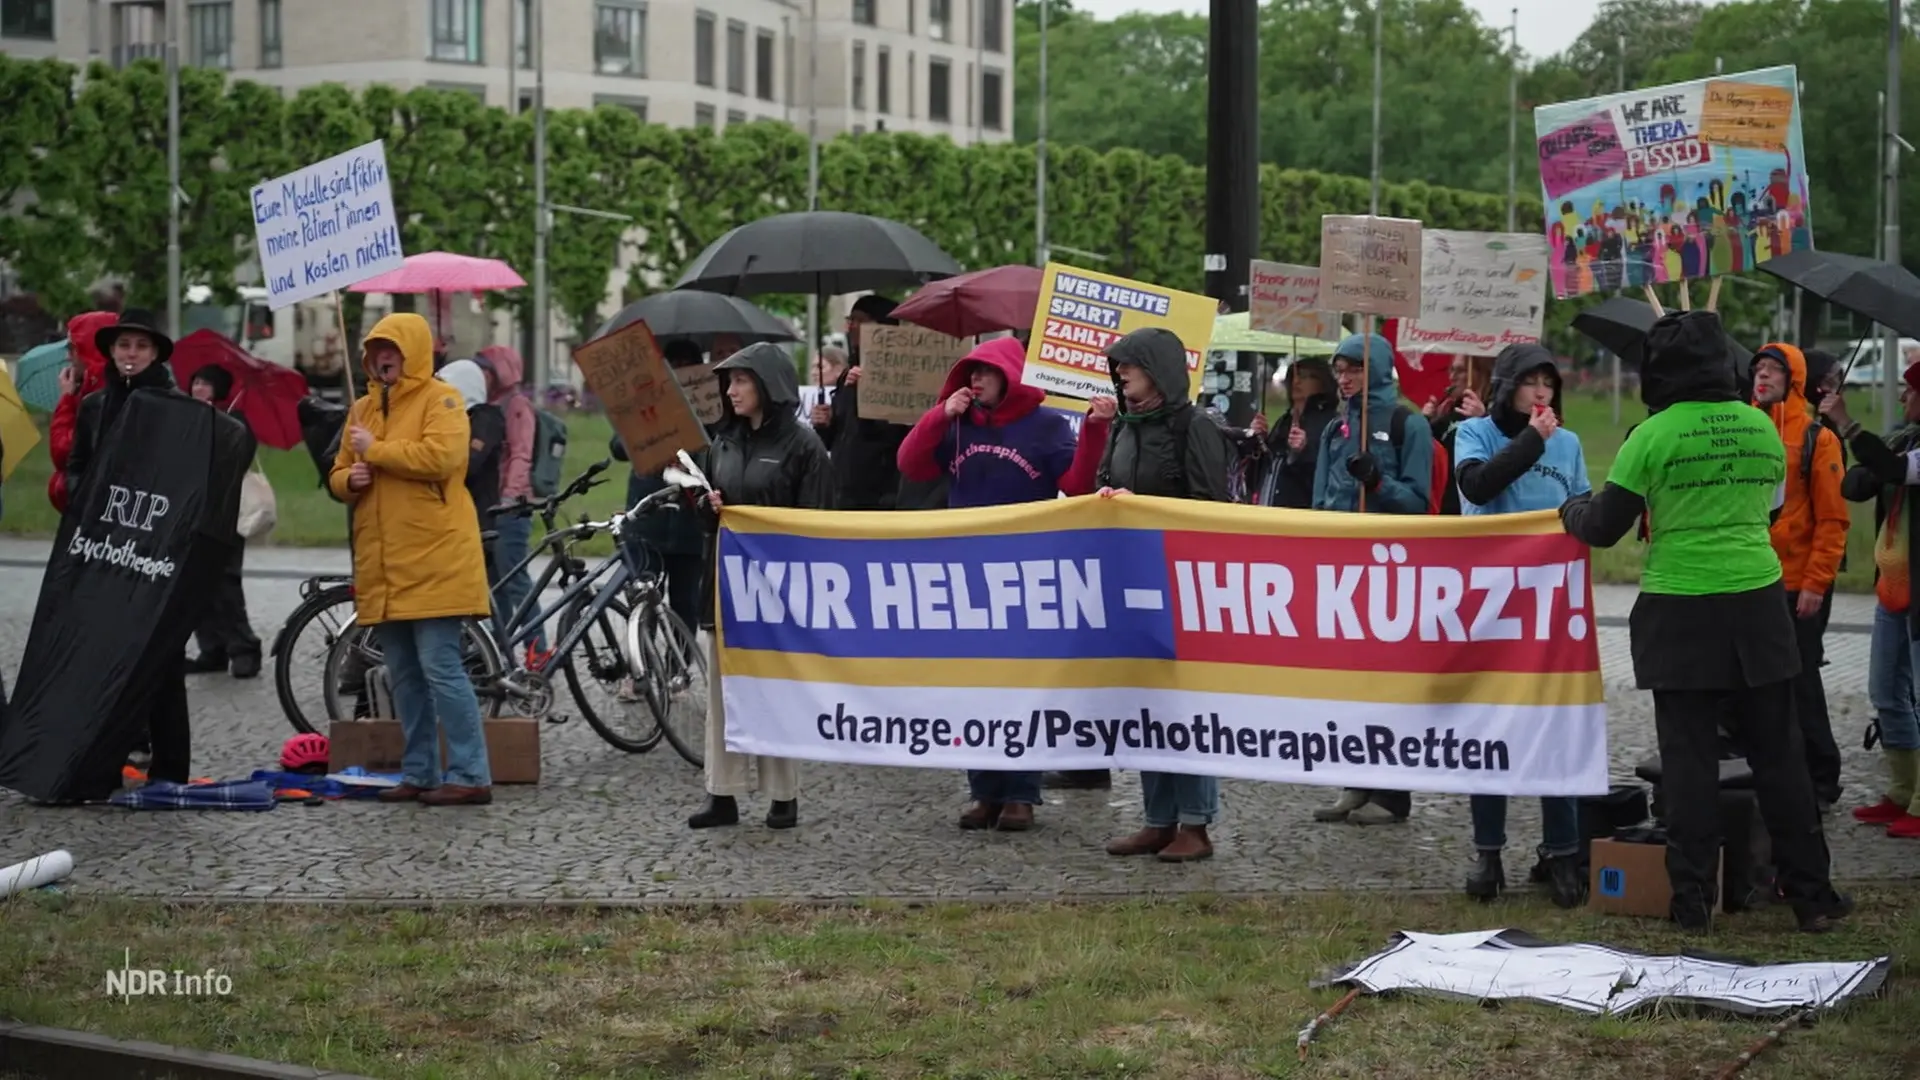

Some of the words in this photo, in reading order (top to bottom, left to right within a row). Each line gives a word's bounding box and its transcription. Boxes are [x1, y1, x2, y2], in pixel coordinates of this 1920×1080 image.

[1621, 100, 1649, 126] WE
[1649, 94, 1687, 121] ARE
[1628, 118, 1694, 146] THERA-
[1626, 139, 1703, 177] PISSED
[253, 189, 282, 224] Eure
[282, 175, 329, 216] Modelle
[329, 161, 351, 199] sind
[351, 156, 384, 197] fiktiv
[266, 228, 299, 257] meine
[270, 268, 297, 296] und
[304, 249, 349, 285] Kosten
[355, 225, 398, 269] nicht!
[1056, 274, 1101, 299] WER
[1103, 285, 1170, 315] HEUTE
[1049, 298, 1119, 329] SPART,
[1044, 320, 1111, 348] ZAHLT
[1039, 343, 1111, 373] DOPPE
[1701, 413, 1739, 425] STOPP
[1711, 437, 1739, 448] NEIN
[965, 442, 1042, 480] therapissed
[1720, 462, 1734, 473] JA
[99, 484, 169, 531] RIP
[722, 555, 857, 630] WIR
[866, 557, 1107, 631] HELFEN
[1174, 560, 1299, 638] IHR
[1315, 542, 1588, 643] KÜRZT!
[816, 702, 1511, 771] change.org/PsychotherapieRetten
